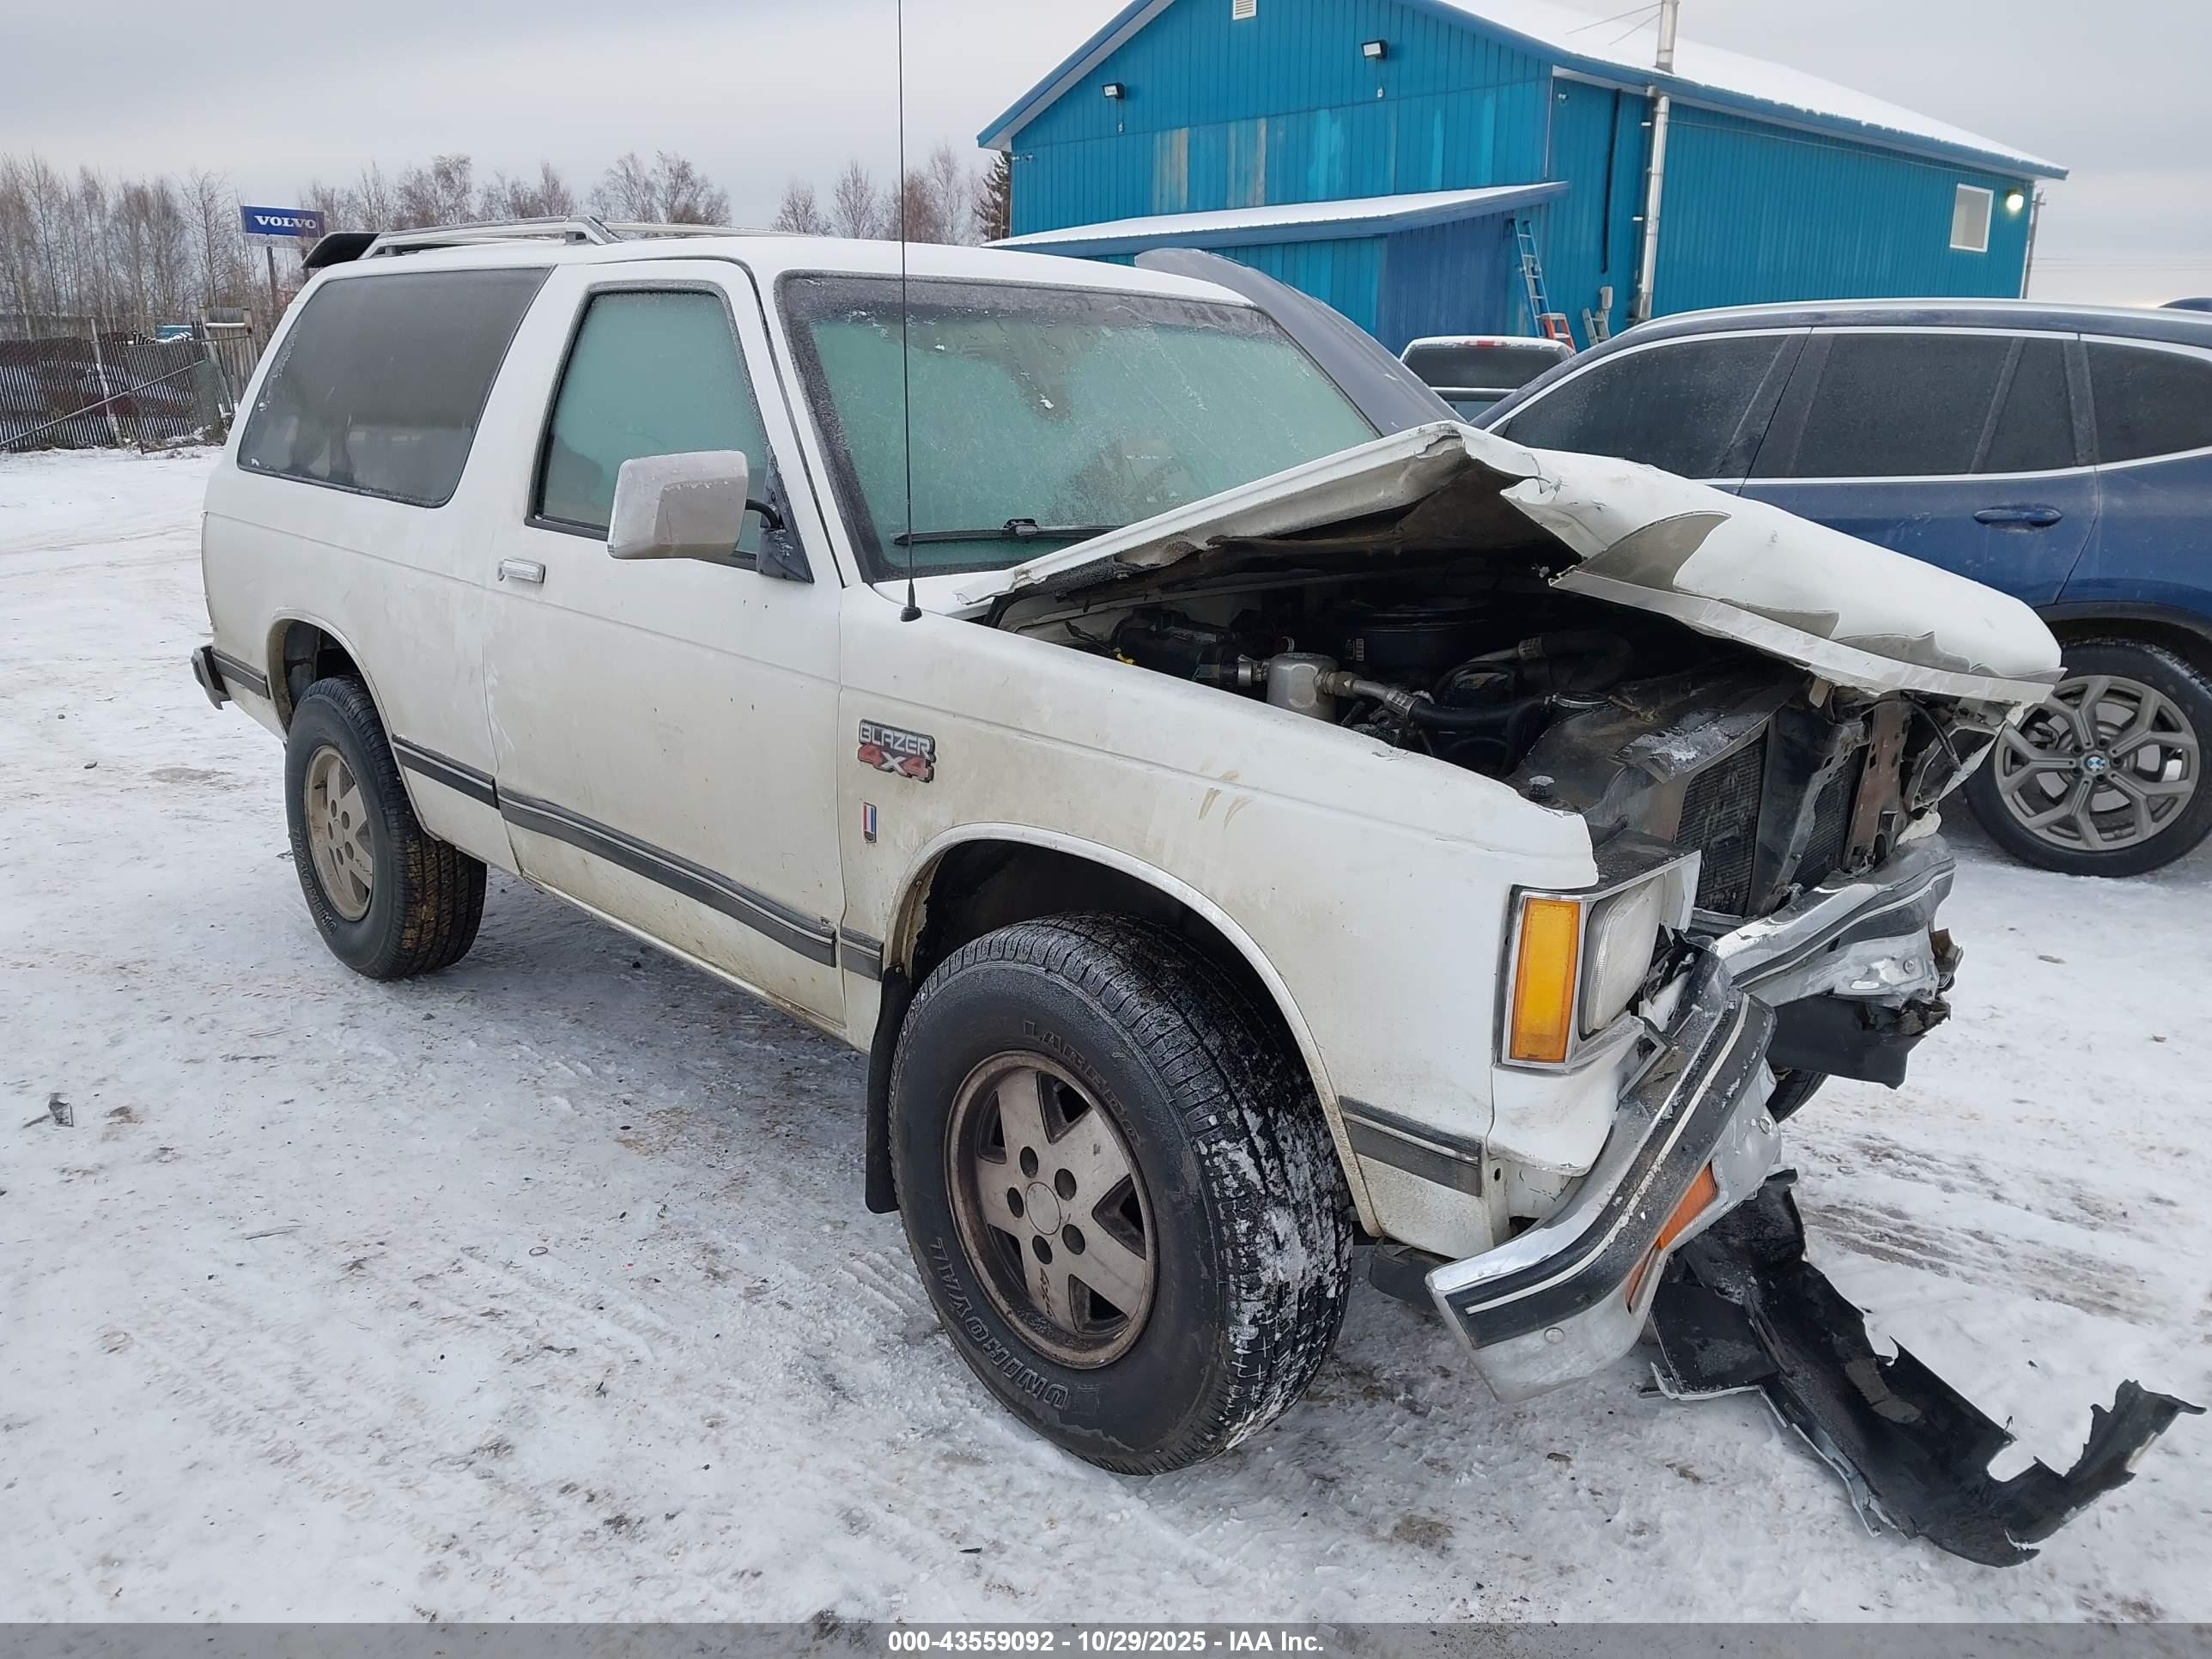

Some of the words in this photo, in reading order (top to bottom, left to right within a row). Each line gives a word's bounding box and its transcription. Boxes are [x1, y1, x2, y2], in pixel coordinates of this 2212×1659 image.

[253, 215, 317, 229] VOLVO
[860, 723, 930, 759] BLAZER
[1023, 1019, 1141, 1147] LAREDO
[928, 1236, 1070, 1410] UNIROYAL
